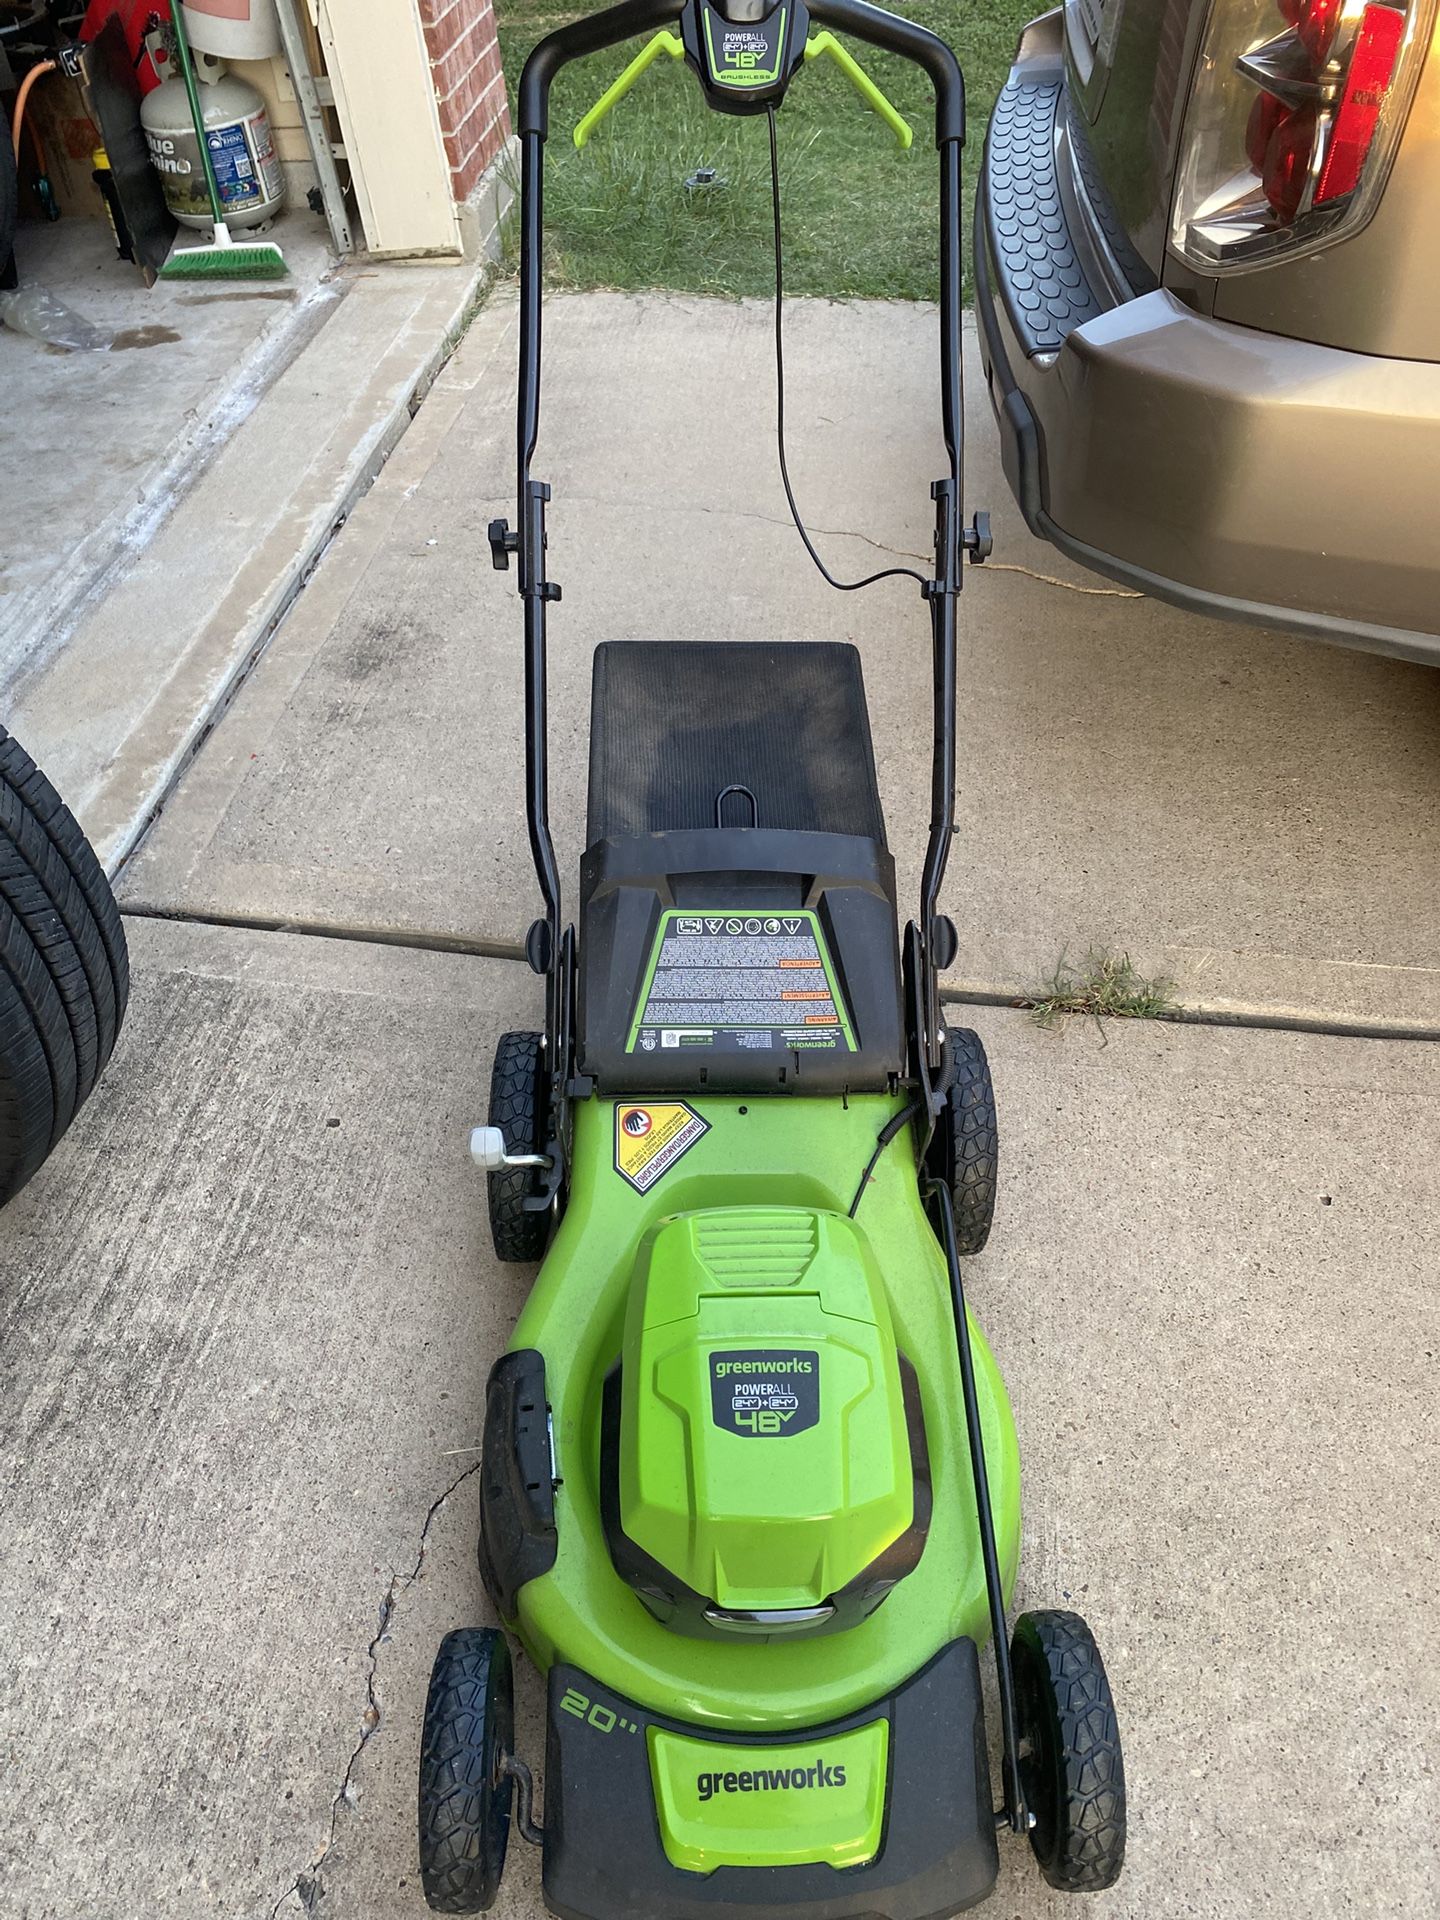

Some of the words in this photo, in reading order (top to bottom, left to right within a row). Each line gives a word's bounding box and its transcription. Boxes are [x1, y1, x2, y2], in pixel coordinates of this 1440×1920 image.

[725, 33, 766, 41] POWERALL
[724, 52, 766, 68] 48V
[147, 134, 175, 155] lue
[150, 153, 191, 174] hino
[785, 1040, 837, 1049] greenworks
[636, 1120, 699, 1184] DANGER/DANGER/PELIGRO
[716, 1357, 813, 1378] greenworks
[734, 1383, 795, 1395] POWERALL
[734, 1399, 757, 1408] 24V
[771, 1399, 794, 1407] 24V
[734, 1411, 796, 1433] 48V
[697, 1759, 847, 1801] greenworks
